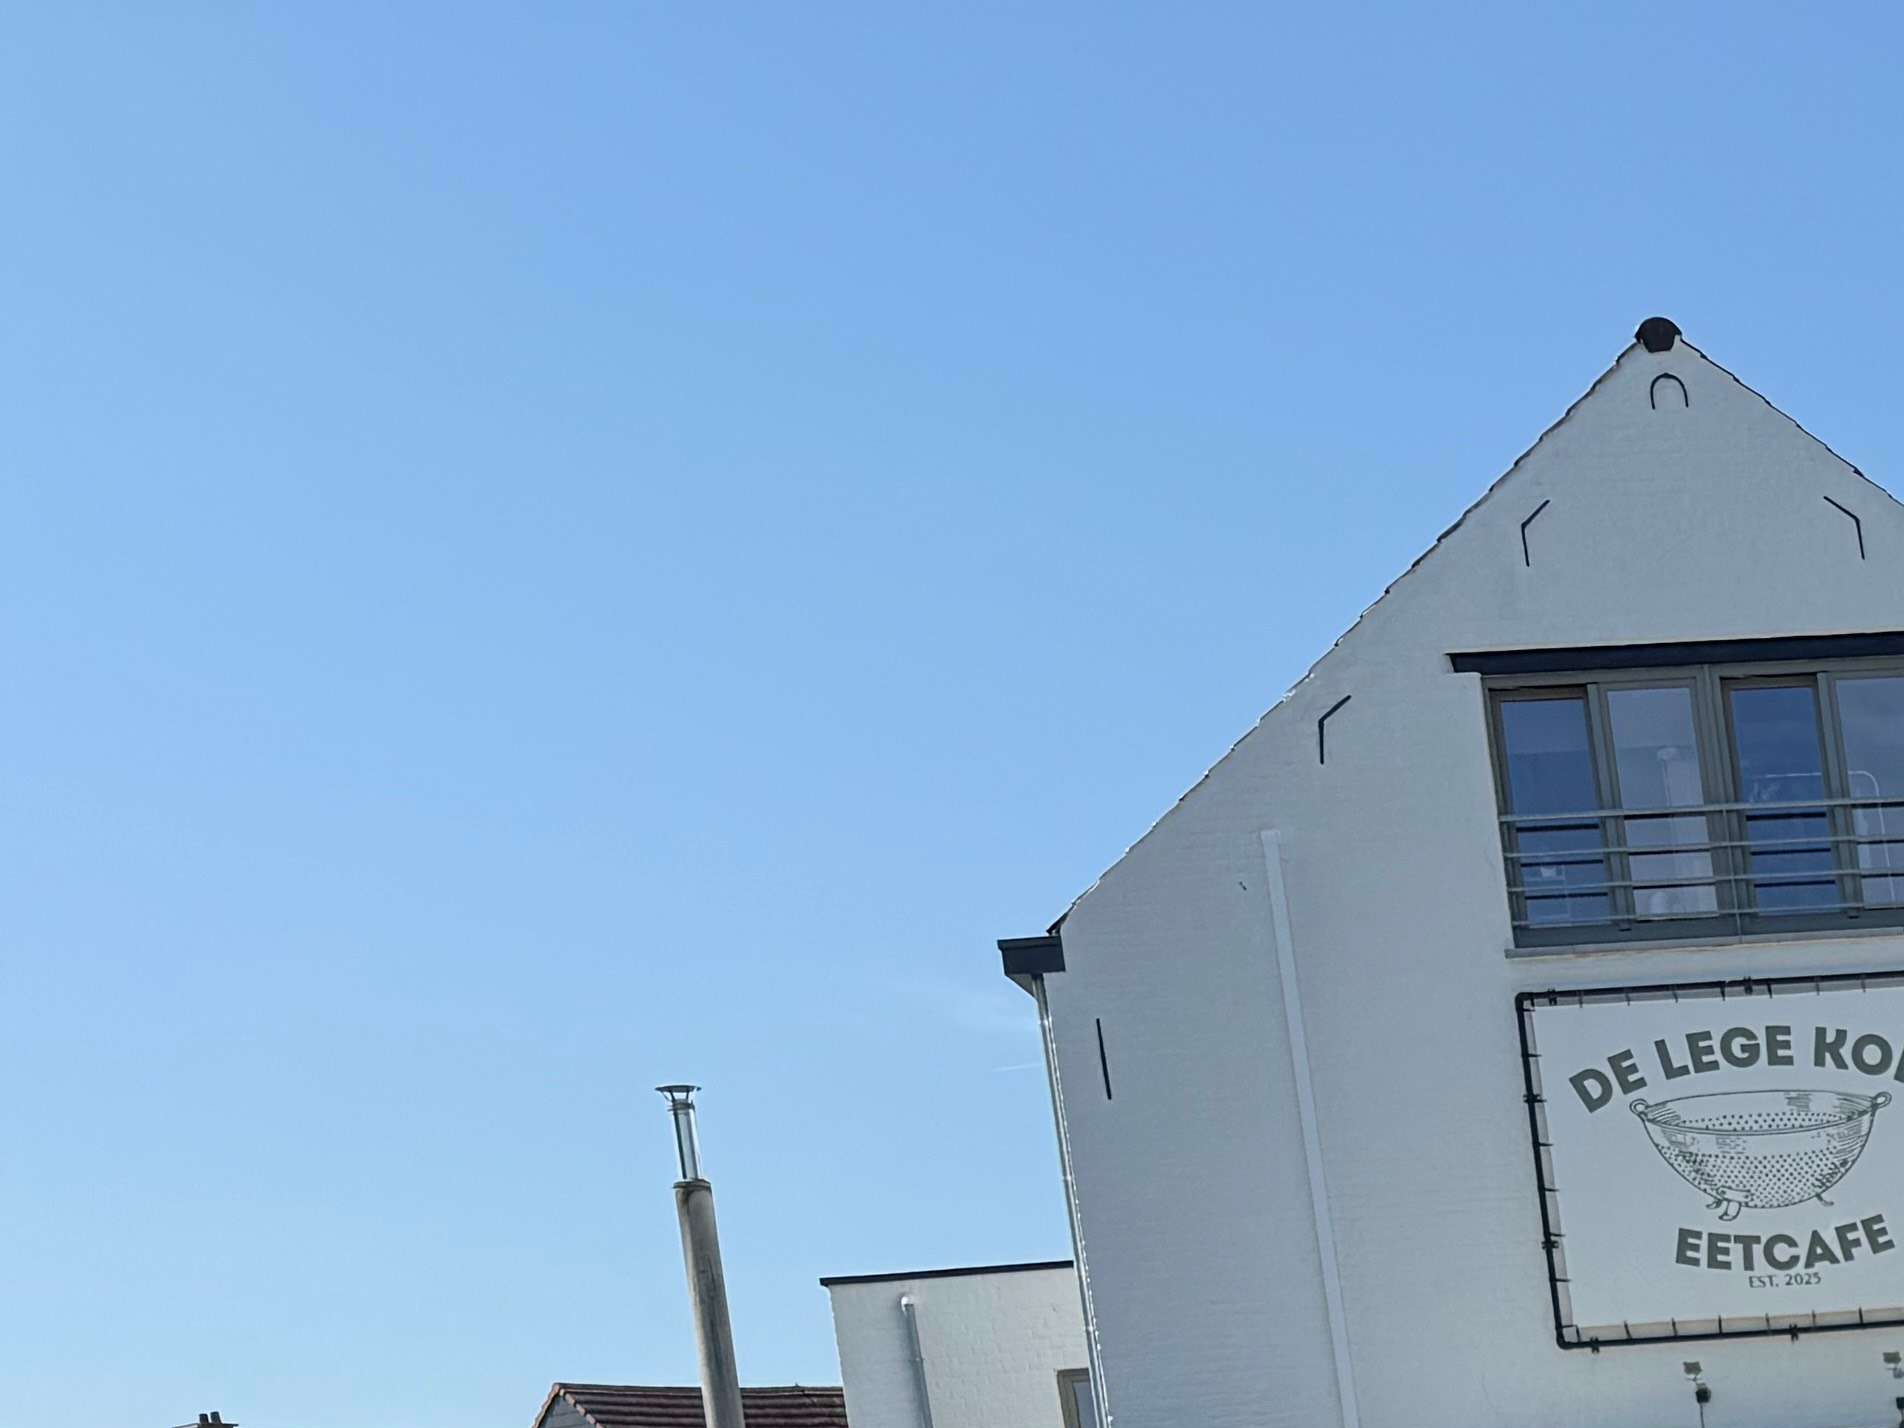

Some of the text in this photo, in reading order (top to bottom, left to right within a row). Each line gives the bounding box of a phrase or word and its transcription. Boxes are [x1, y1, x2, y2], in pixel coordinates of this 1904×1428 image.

[1569, 1049, 1647, 1113] DE
[1655, 1025, 1795, 1080] LEGE
[1675, 1213, 1895, 1272] EETCAFE
[1748, 1271, 1822, 1289] EST. 2025
